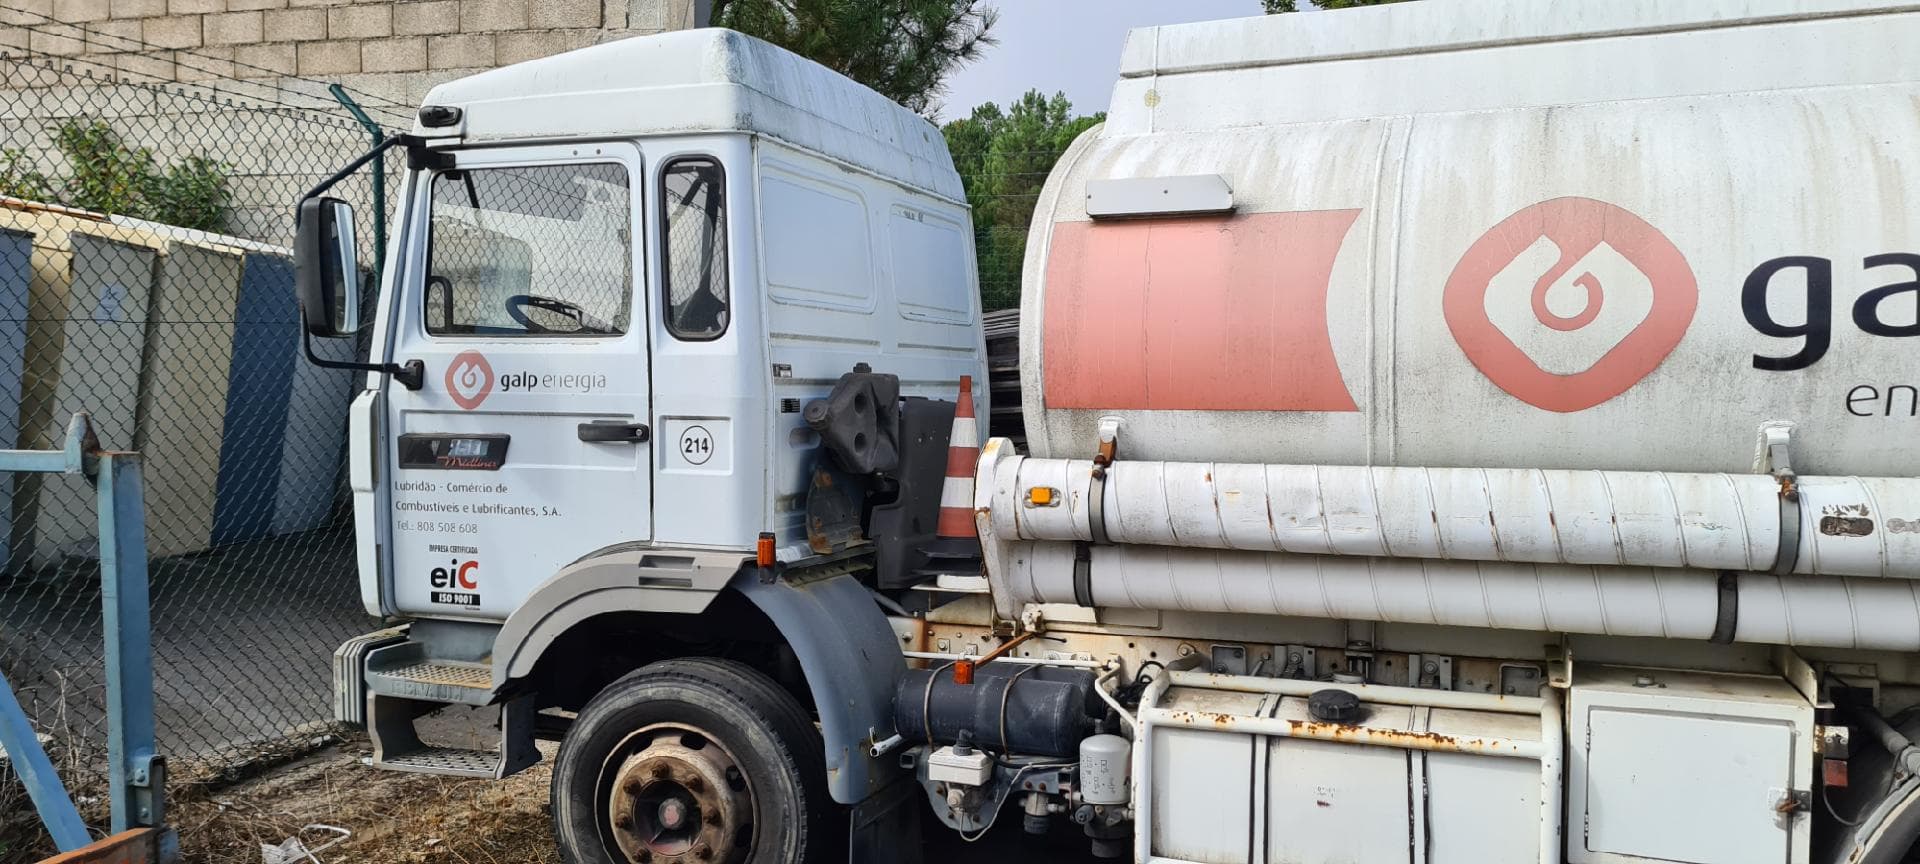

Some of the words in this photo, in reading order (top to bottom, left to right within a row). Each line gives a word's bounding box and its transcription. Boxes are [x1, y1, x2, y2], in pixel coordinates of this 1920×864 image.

[501, 371, 538, 392] galp
[542, 372, 606, 393] energia
[1846, 385, 1918, 417] en
[685, 437, 709, 453] 214
[395, 481, 436, 492] Lubridão
[447, 482, 492, 493] Comércio
[496, 484, 508, 493] de
[396, 501, 459, 513] Combustíveis
[463, 505, 469, 513] e
[472, 504, 539, 516] Lubrificantes,
[542, 507, 562, 516] S.A.
[417, 522, 434, 532] 808
[438, 523, 455, 533] 508
[459, 523, 478, 534] 608
[439, 593, 452, 602] ISO
[454, 595, 472, 604] 9001
